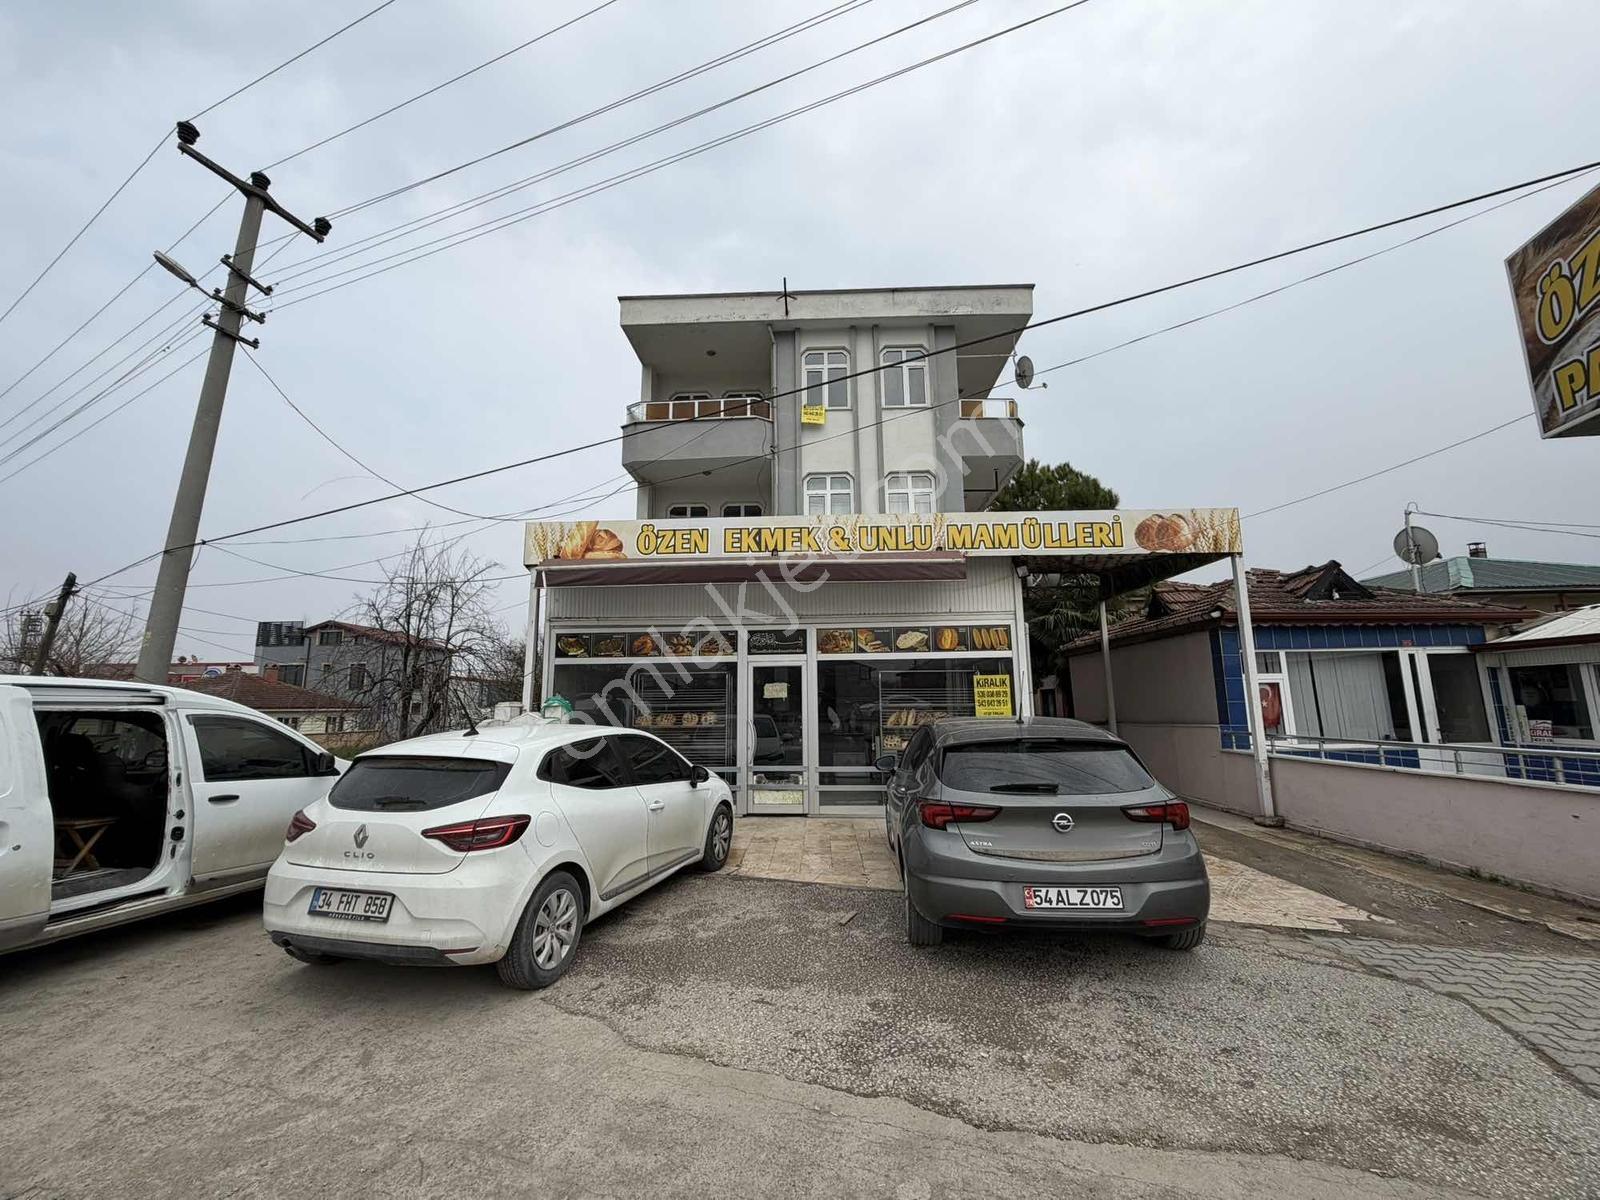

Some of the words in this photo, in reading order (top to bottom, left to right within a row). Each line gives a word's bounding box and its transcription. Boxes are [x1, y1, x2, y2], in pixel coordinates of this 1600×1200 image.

[637, 523, 709, 556] ÖZEN
[724, 526, 823, 554] EKMEK
[827, 525, 852, 552] &
[858, 523, 933, 552] UNLU
[947, 515, 1124, 550] MAMÜLLERİ
[344, 851, 375, 859] CLIO
[318, 891, 333, 910] 34
[337, 893, 361, 912] FHT
[363, 896, 388, 915] 858
